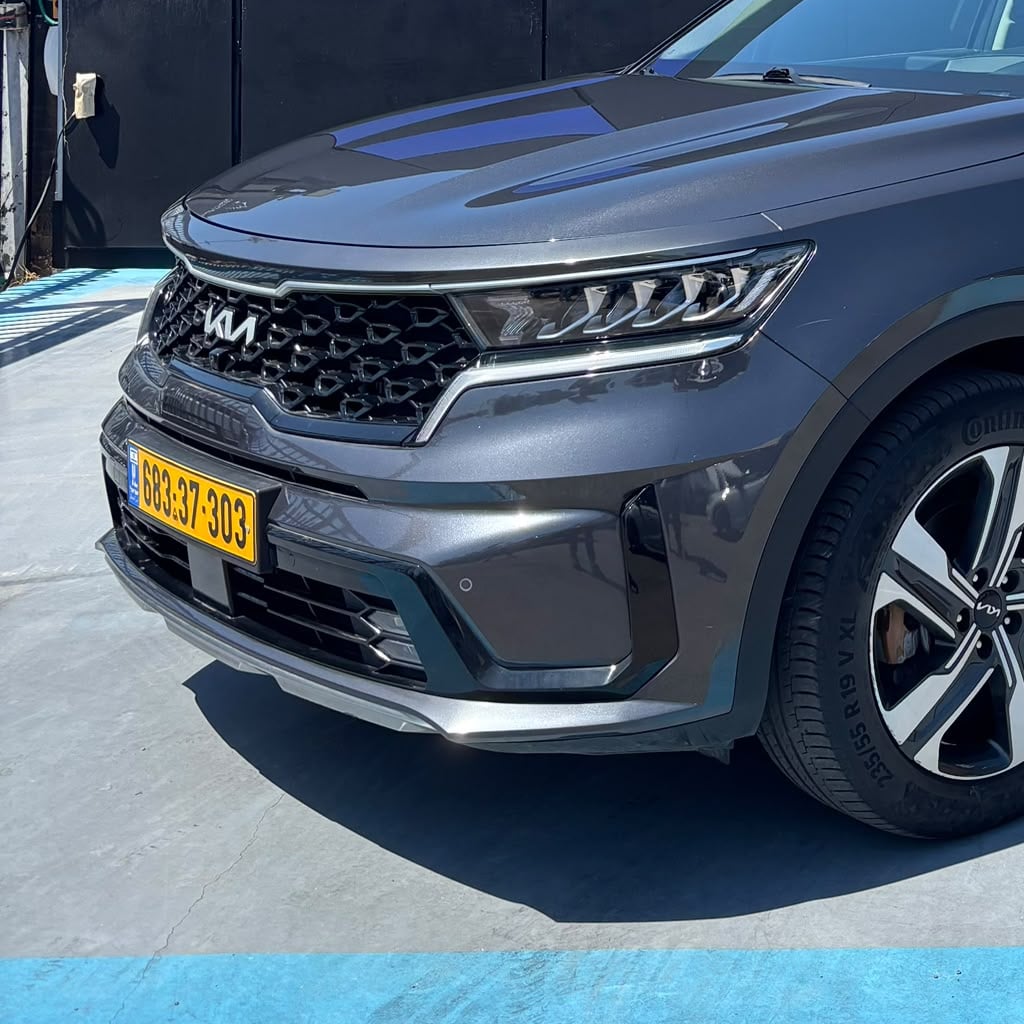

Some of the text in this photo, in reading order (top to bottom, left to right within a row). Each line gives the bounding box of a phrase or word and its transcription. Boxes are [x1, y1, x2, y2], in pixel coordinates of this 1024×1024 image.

[204, 305, 257, 346] KIA
[839, 612, 894, 788] 235/55 R 19 V XL
